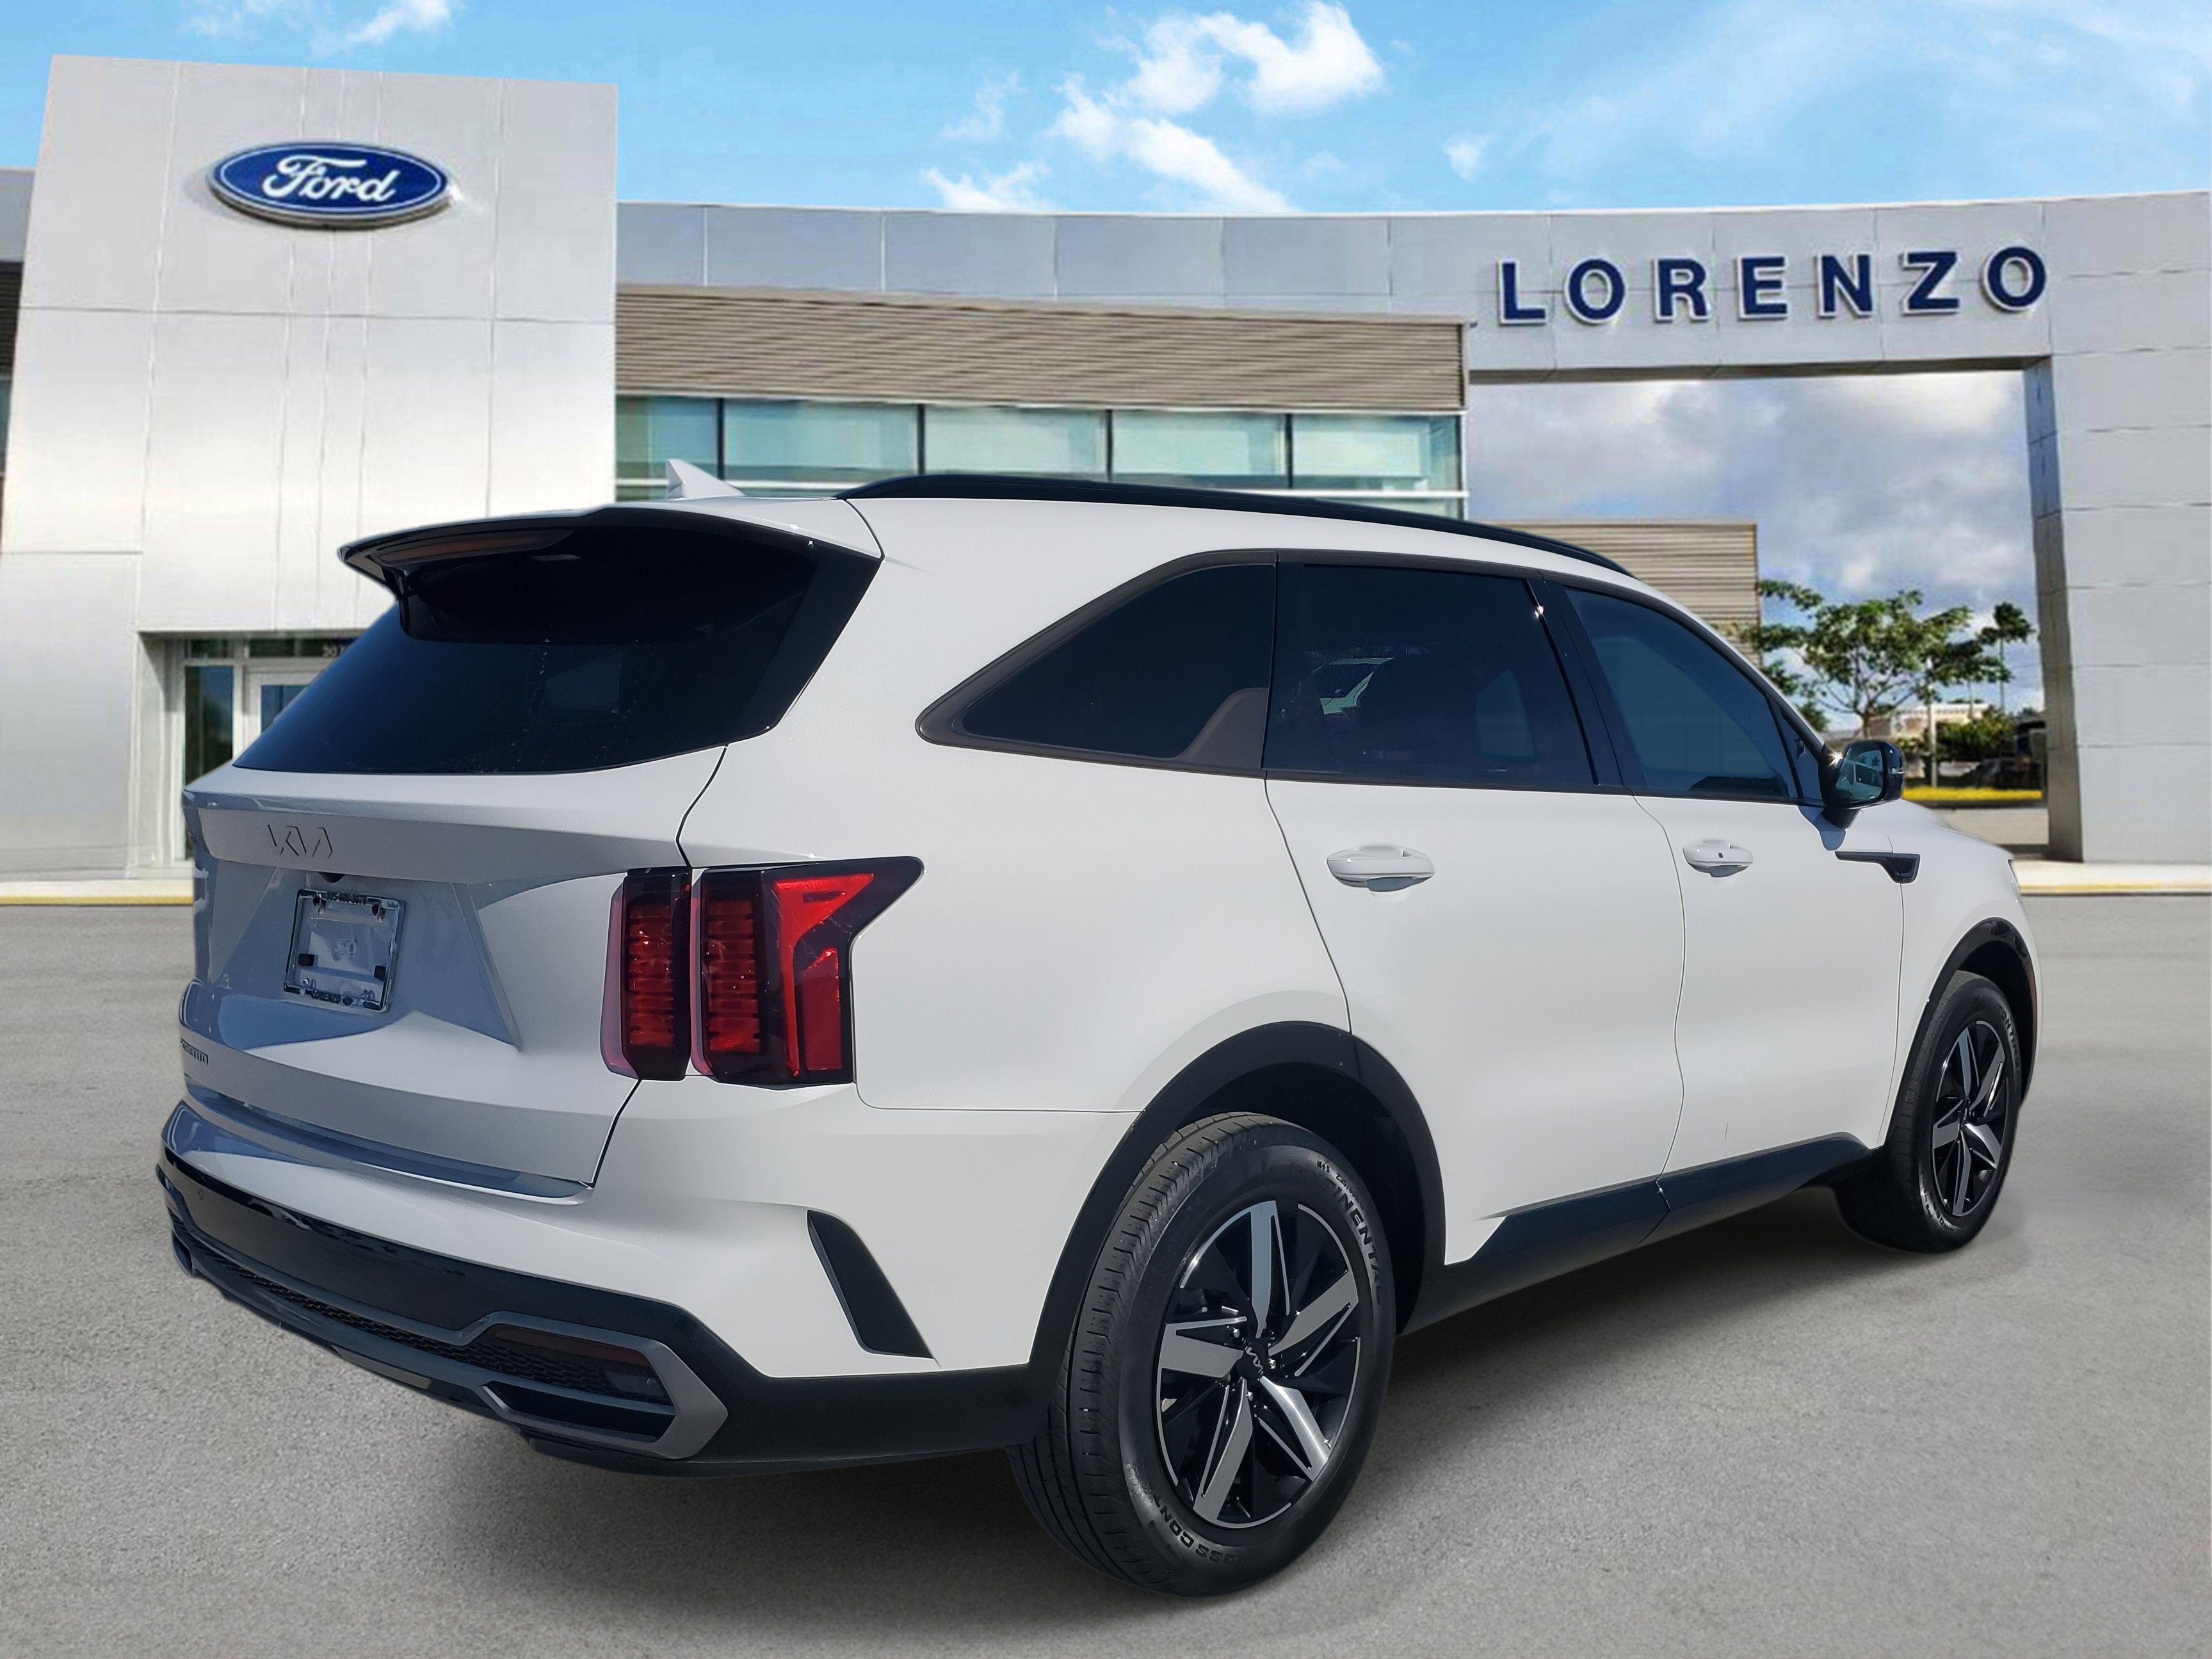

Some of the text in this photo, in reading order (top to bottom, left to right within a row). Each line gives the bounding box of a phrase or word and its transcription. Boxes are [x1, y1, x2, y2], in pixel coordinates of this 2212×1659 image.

[262, 154, 400, 202] Ford
[1501, 246, 2047, 321] LORENZO
[268, 824, 333, 858] KIA
